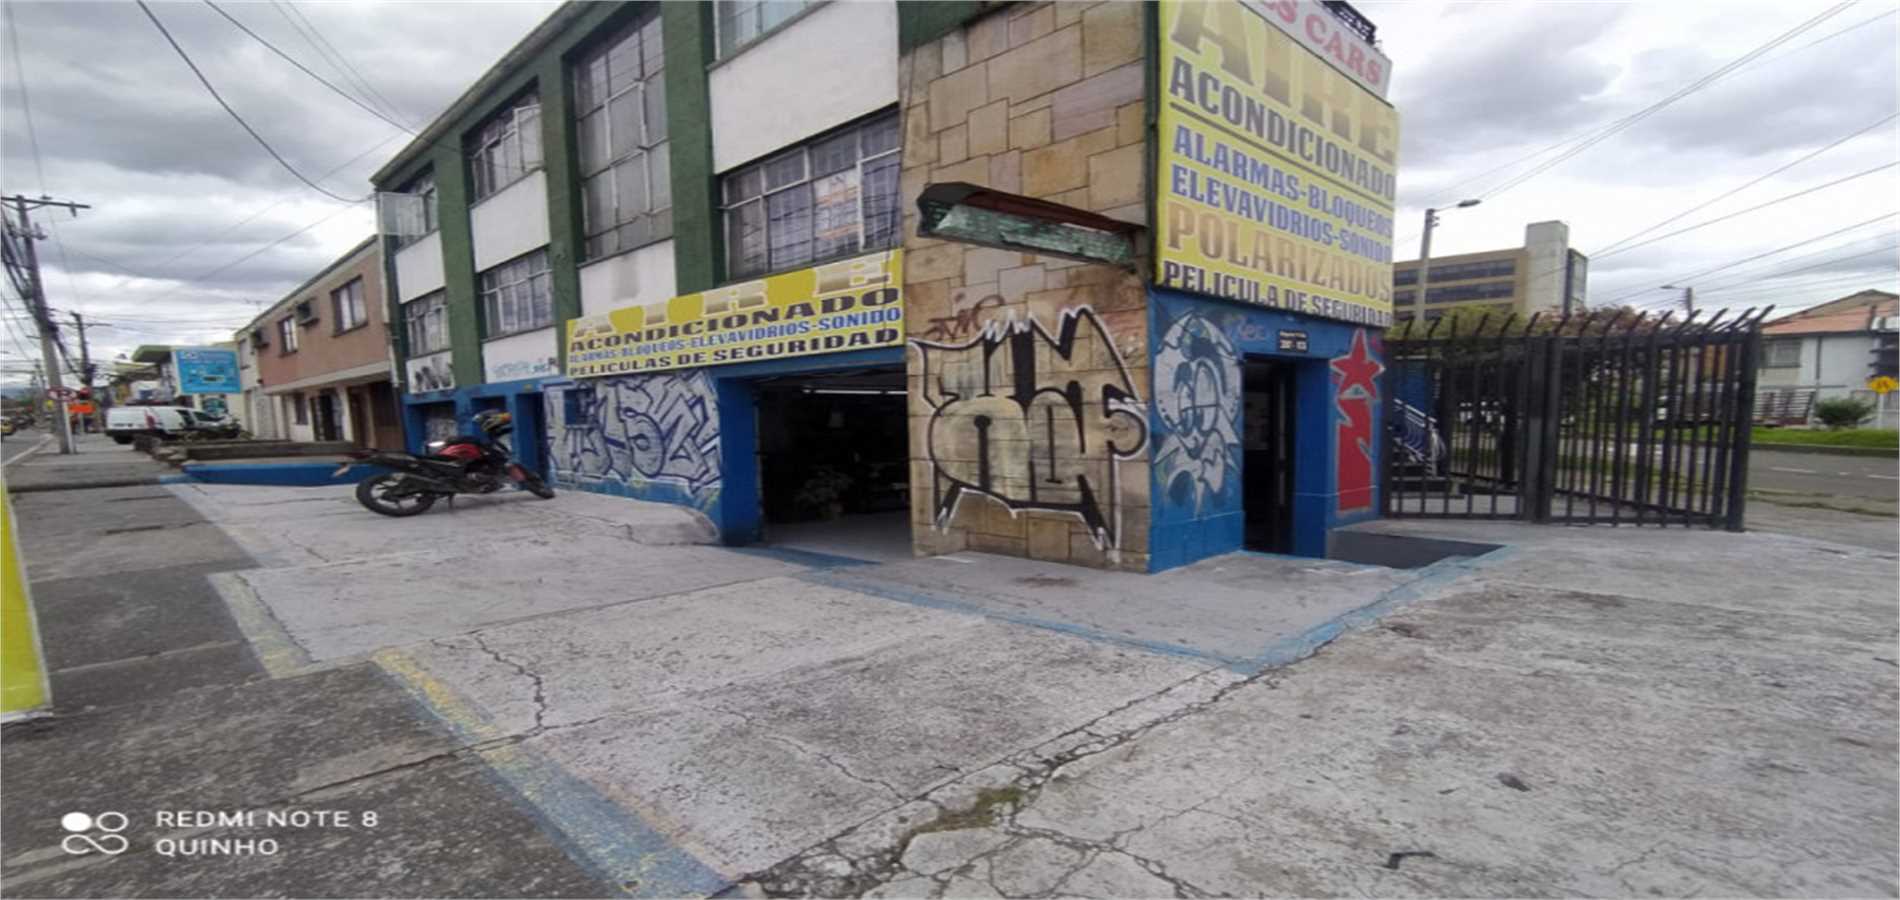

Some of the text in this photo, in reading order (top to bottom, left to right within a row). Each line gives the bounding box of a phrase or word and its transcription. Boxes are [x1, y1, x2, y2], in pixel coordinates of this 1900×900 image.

[1170, 0, 1395, 165] AIRE
[1305, 14, 1382, 85] CARS
[1169, 55, 1395, 201] ACONDICIONADO
[1163, 260, 1279, 308] PELICULA
[1285, 289, 1307, 313] DE
[1167, 200, 1391, 303] POLARIZADOS
[570, 355, 671, 375] PELICULAS
[678, 351, 703, 365] DE
[713, 328, 899, 361] SEGURIDAD
[571, 288, 899, 352] ACONDICIONADO
